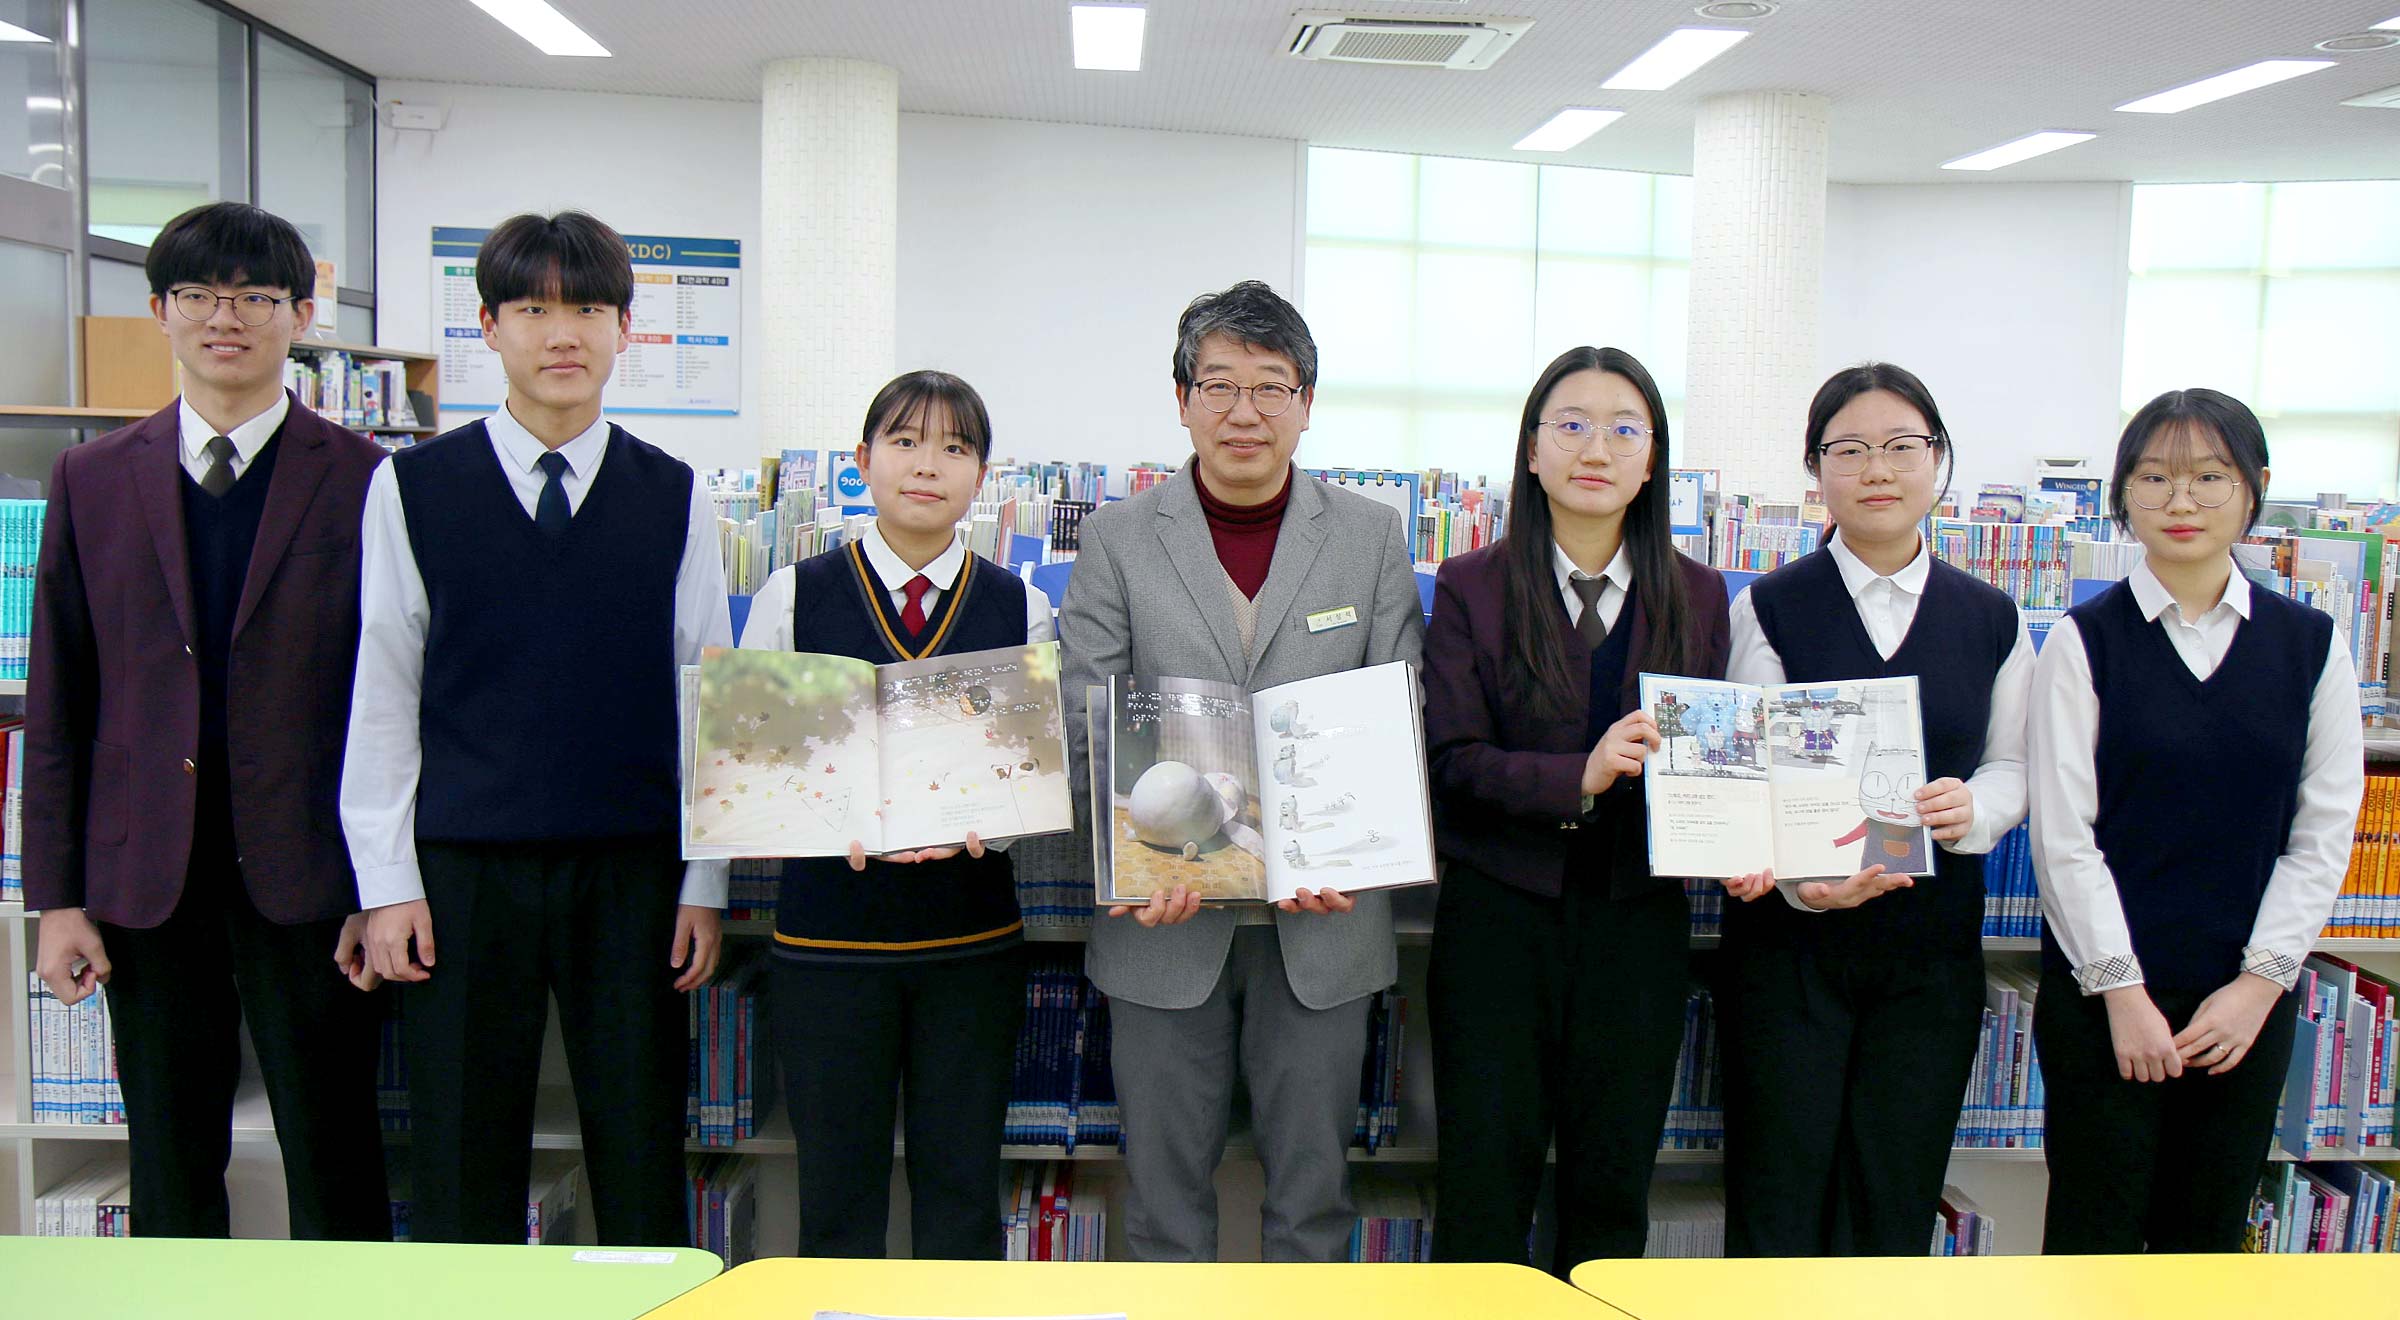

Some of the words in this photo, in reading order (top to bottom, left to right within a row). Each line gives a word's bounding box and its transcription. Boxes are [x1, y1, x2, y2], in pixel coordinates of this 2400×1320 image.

[680, 275, 709, 285] 자연과학
[711, 277, 726, 286] 400
[840, 477, 864, 487] 900
[2055, 481, 2087, 491] WINGED
